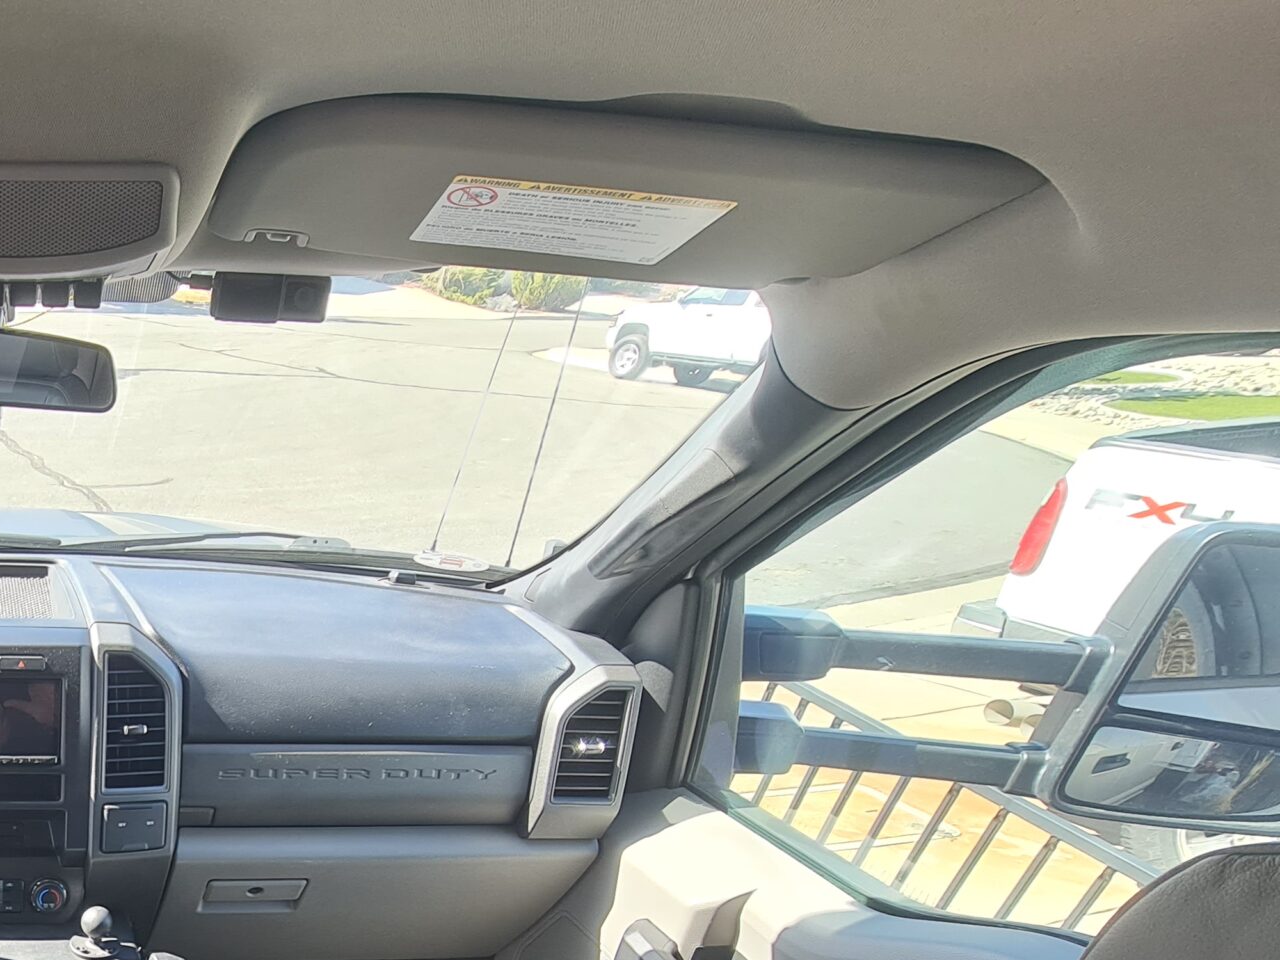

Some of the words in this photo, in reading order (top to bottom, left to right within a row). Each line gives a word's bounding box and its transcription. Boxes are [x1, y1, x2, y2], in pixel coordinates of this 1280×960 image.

[470, 178, 522, 189] WARNING
[543, 184, 634, 199] AVERTISSEMENT
[655, 196, 732, 210] ADVERTENCIA
[217, 768, 372, 782] SUPER
[381, 768, 499, 782] DUTY
